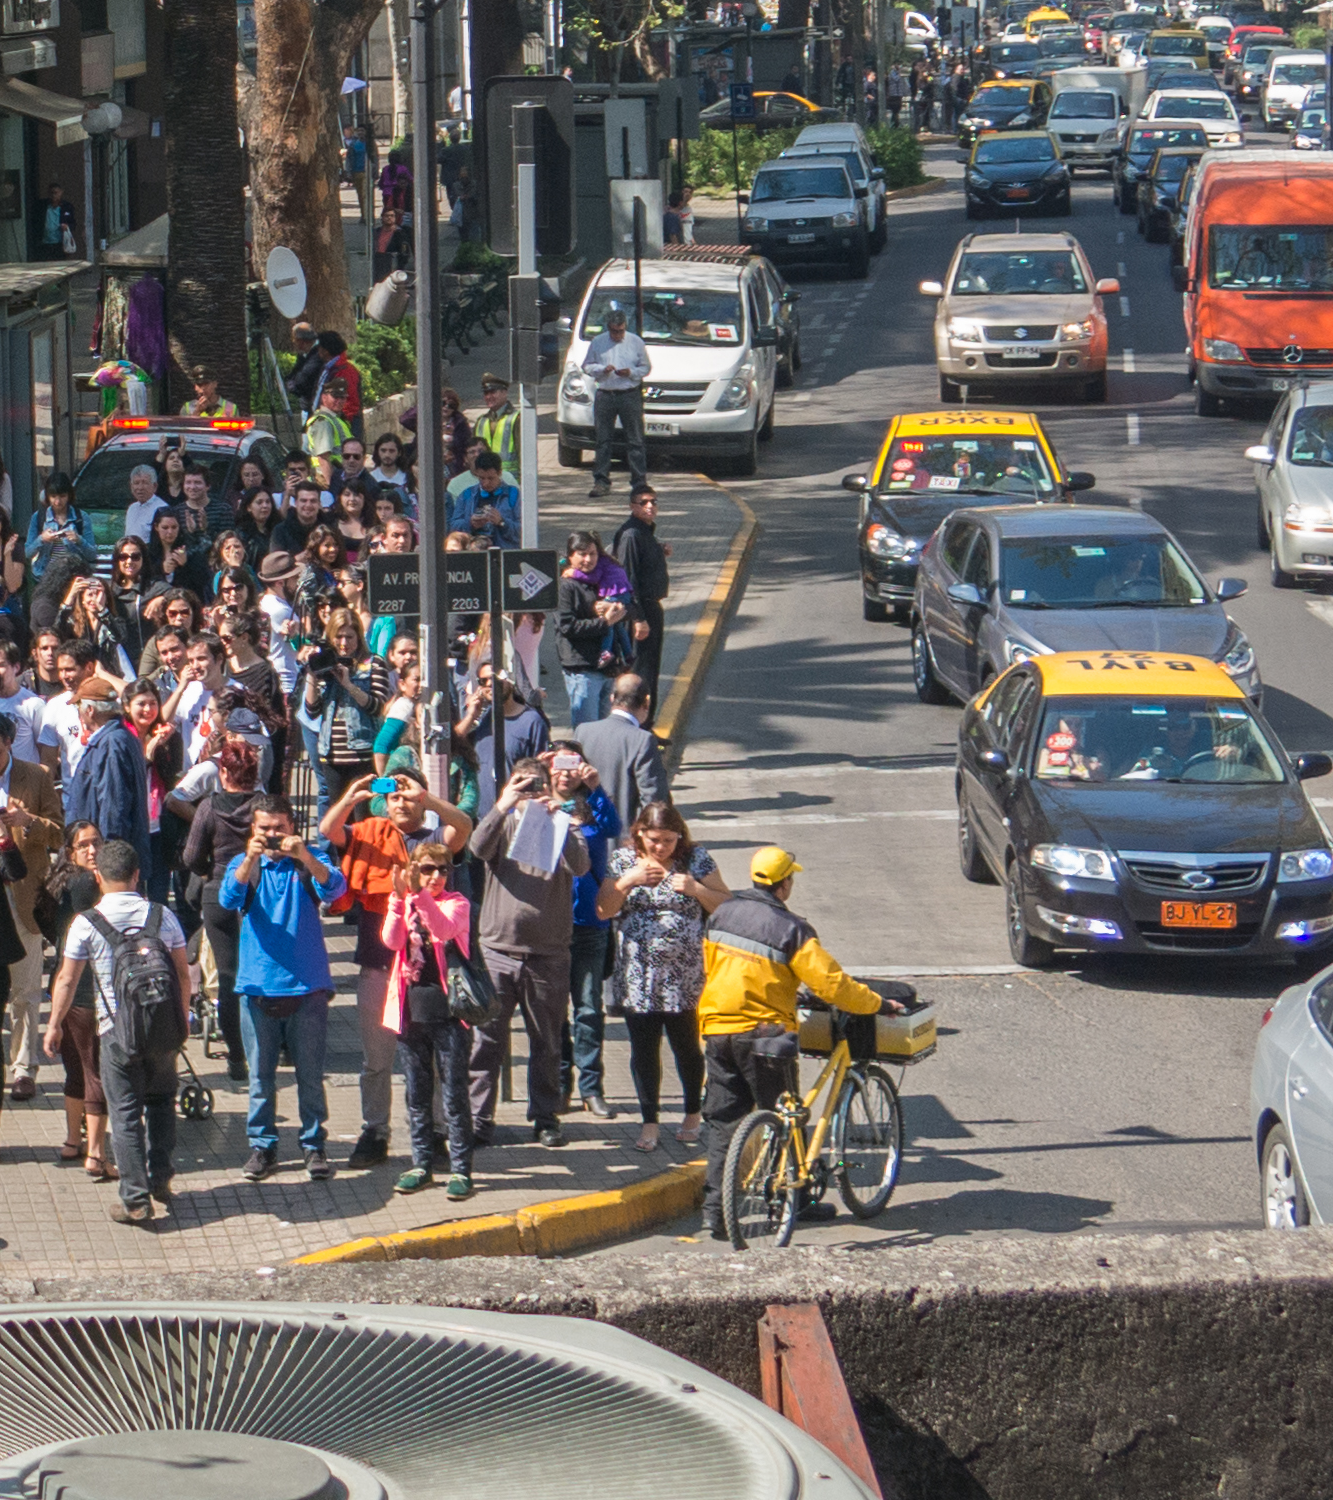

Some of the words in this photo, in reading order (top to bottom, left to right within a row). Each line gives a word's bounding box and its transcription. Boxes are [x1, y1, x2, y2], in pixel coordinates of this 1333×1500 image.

[383, 572, 402, 586] AV.
[377, 599, 406, 613] 2287
[451, 597, 481, 611] 2203
[1066, 659, 1198, 672] BJYL
